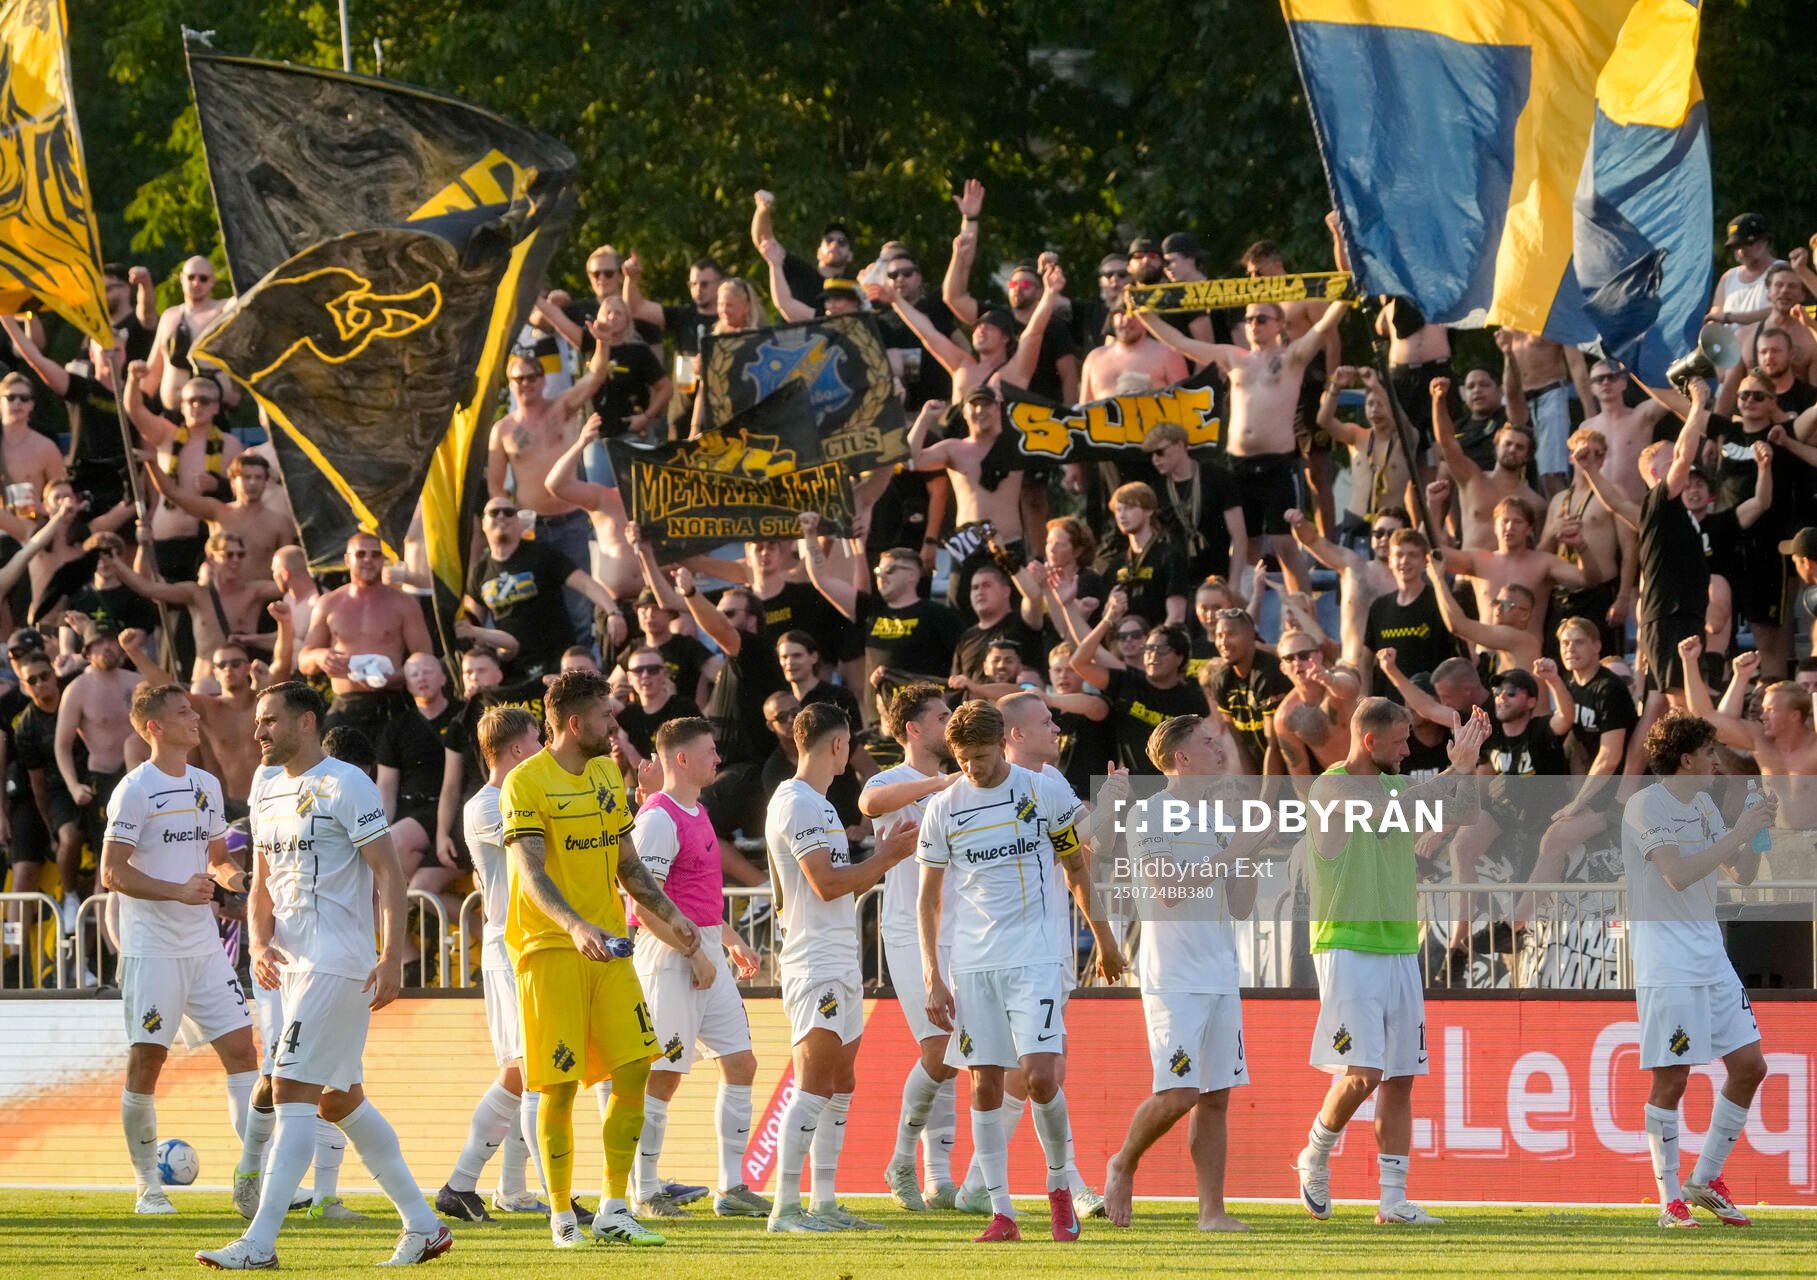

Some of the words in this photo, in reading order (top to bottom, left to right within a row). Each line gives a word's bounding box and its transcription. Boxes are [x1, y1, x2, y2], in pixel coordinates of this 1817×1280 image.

[1008, 386, 1221, 459] S-LINE
[668, 516, 754, 538] NORRA
[966, 837, 1041, 865] truecaller
[226, 978, 246, 1006] 3
[1039, 998, 1054, 1029] 7
[283, 1020, 302, 1054] 4
